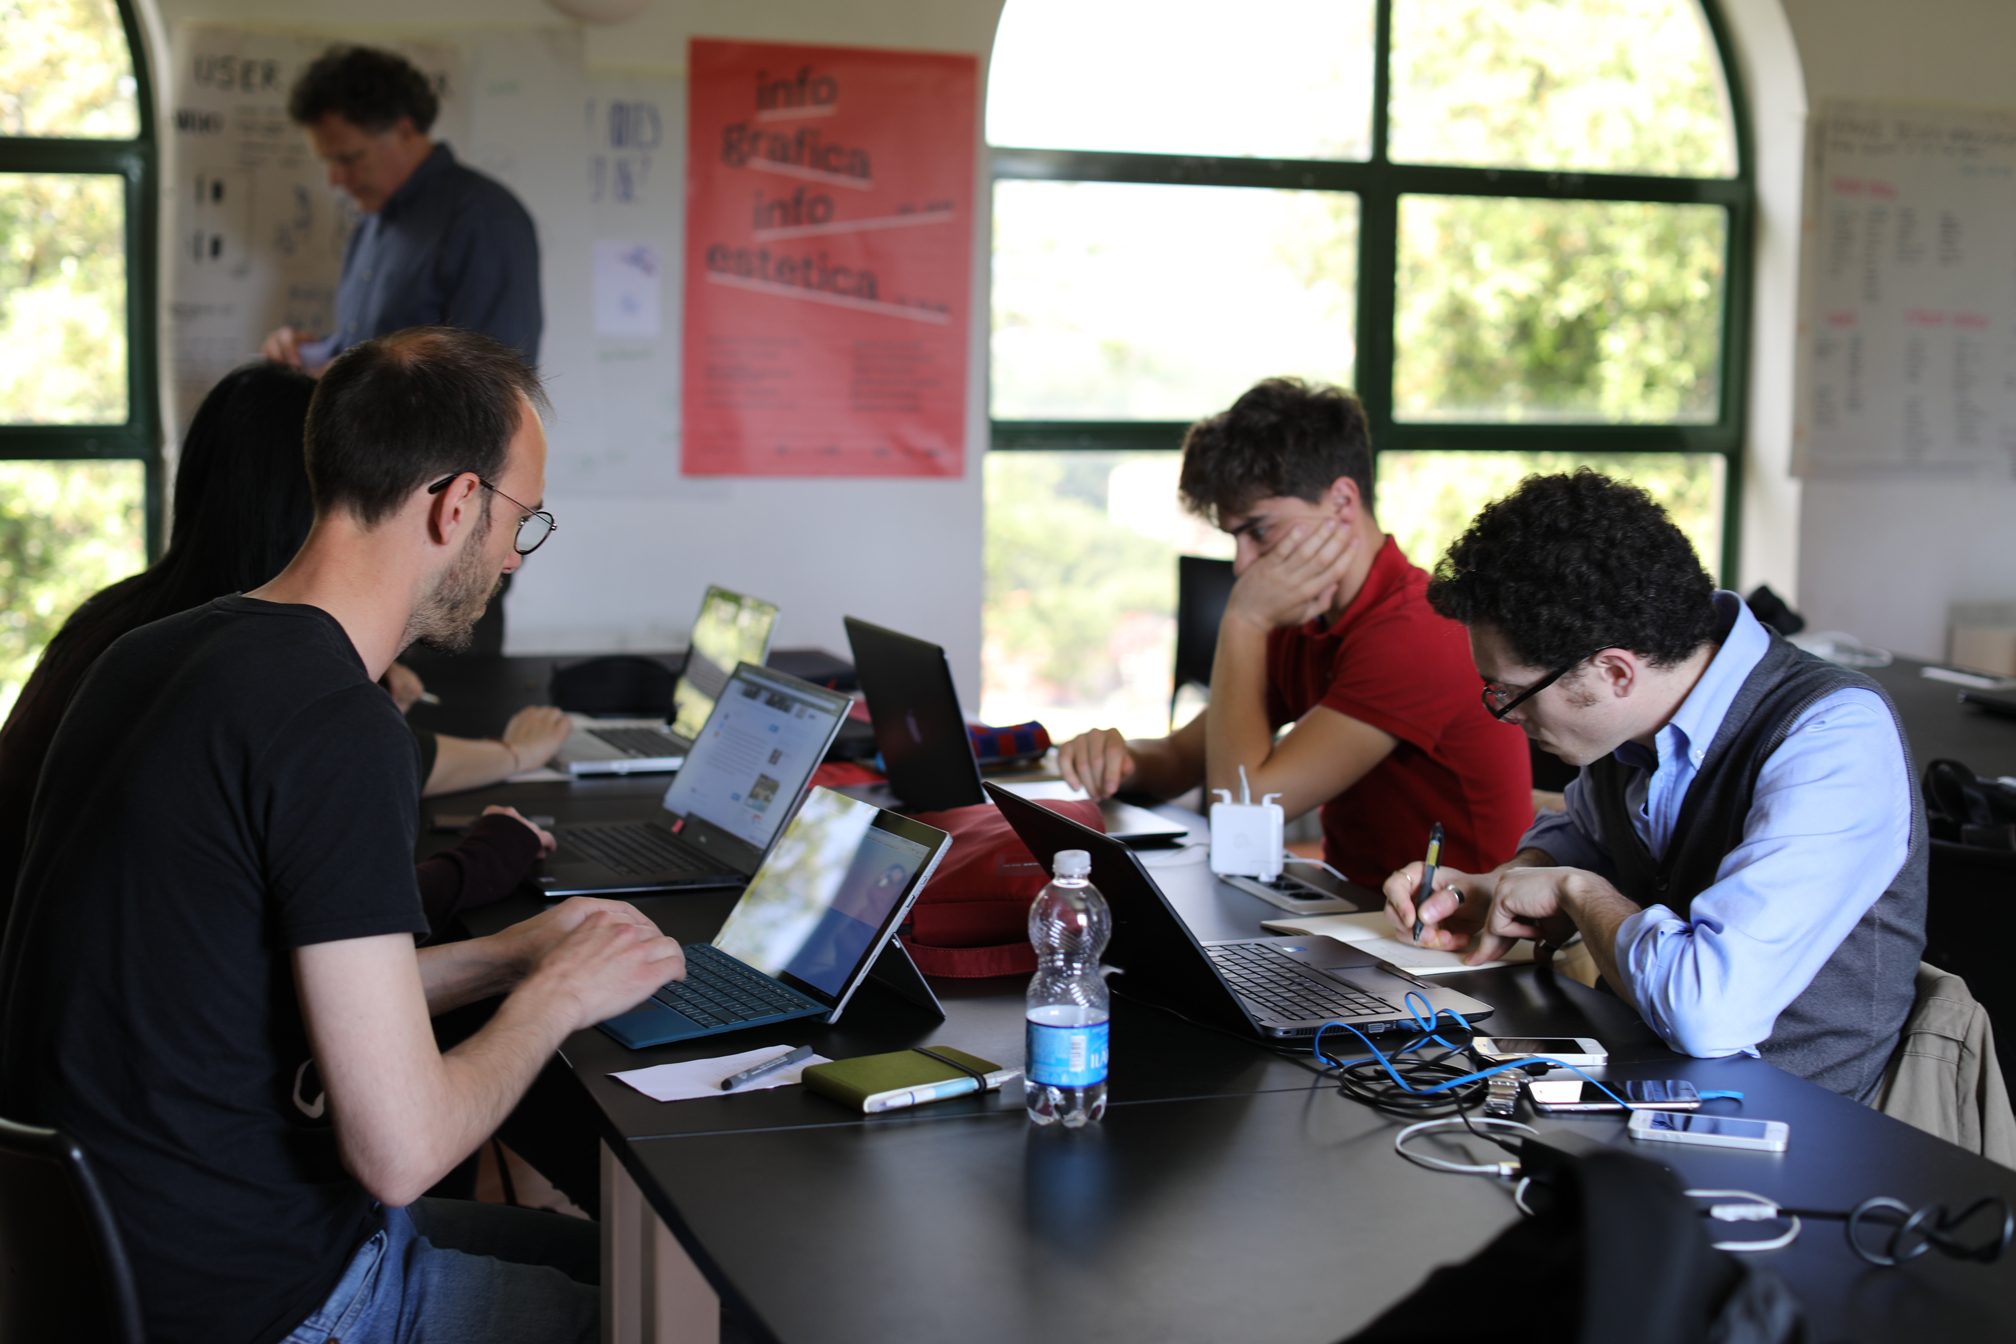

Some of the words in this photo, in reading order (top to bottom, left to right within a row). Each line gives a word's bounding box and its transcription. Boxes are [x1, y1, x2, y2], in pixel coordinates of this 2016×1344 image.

[193, 55, 285, 93] USER
[755, 65, 838, 109] info
[721, 120, 872, 180] grafica
[752, 186, 835, 230] info
[706, 242, 879, 301] estetica
